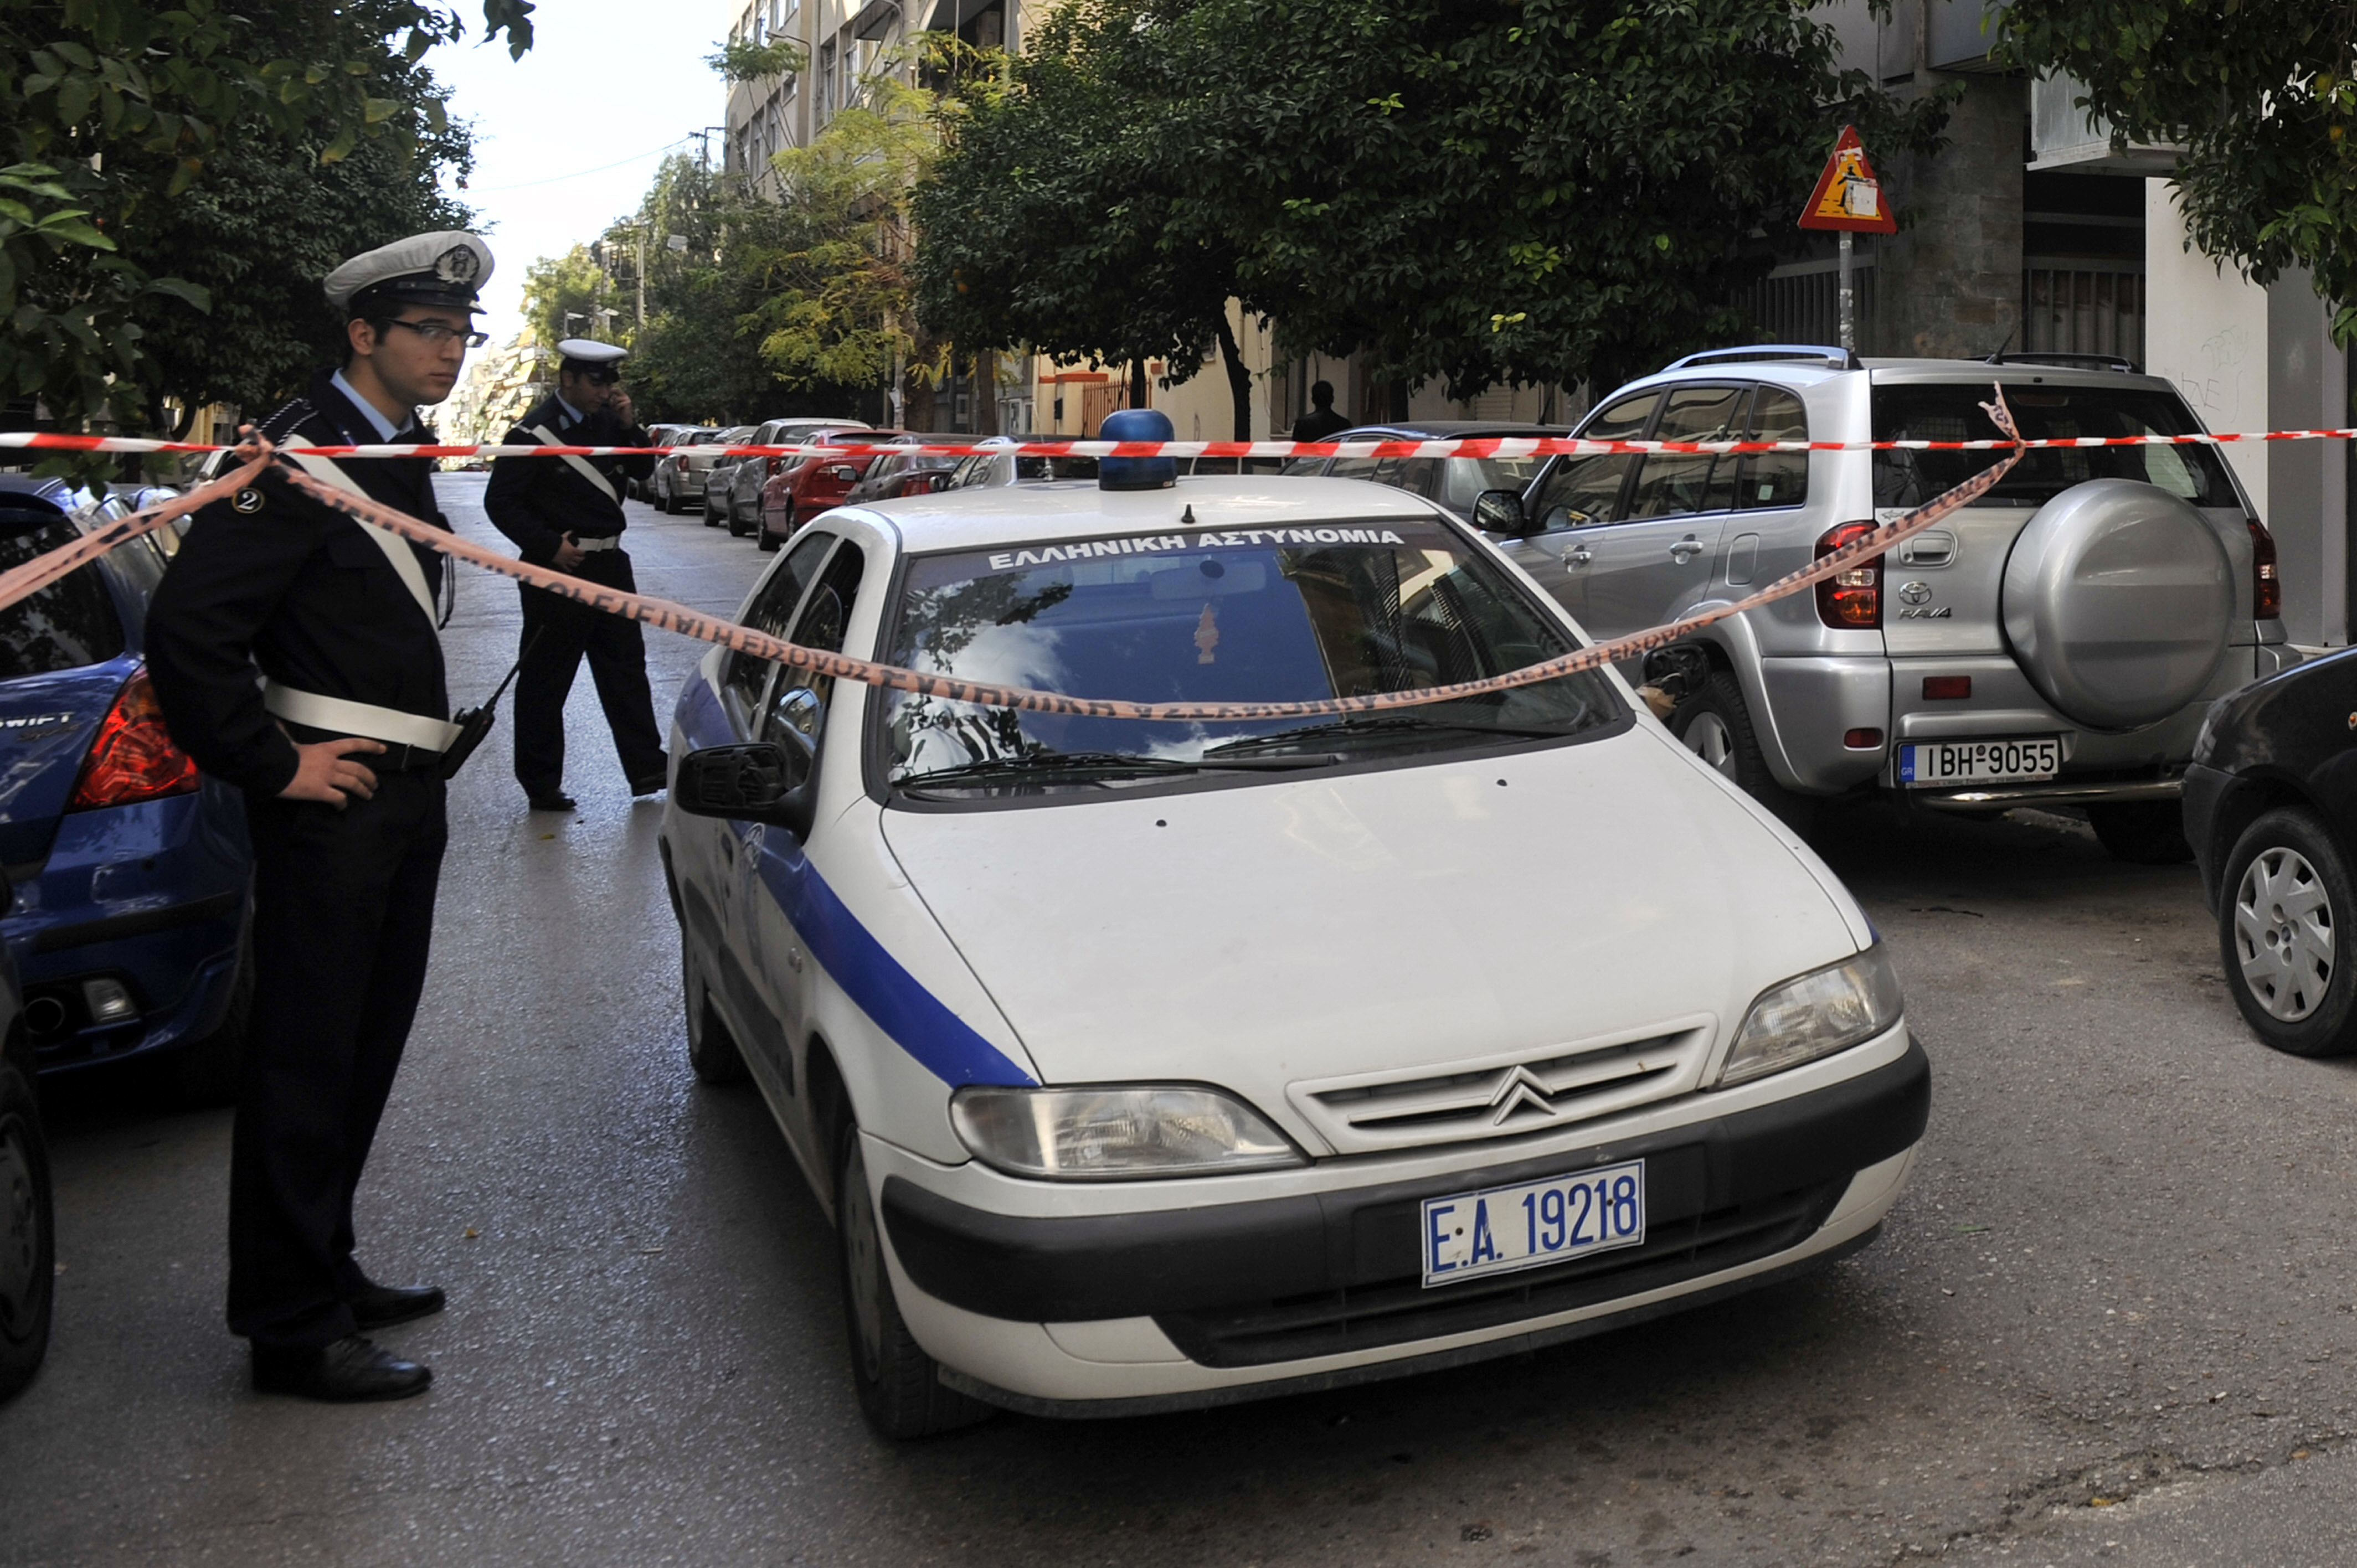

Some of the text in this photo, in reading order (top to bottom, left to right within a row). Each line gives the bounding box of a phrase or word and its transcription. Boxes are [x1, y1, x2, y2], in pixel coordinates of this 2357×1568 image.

[238, 491, 258, 510] 2
[989, 529, 1406, 570] ΕΛΛΗΝΙΚΗ ΑΣΤΥΝΟΜΙΑ
[1901, 767, 1913, 776] GR
[1521, 1175, 1637, 1256] 19218
